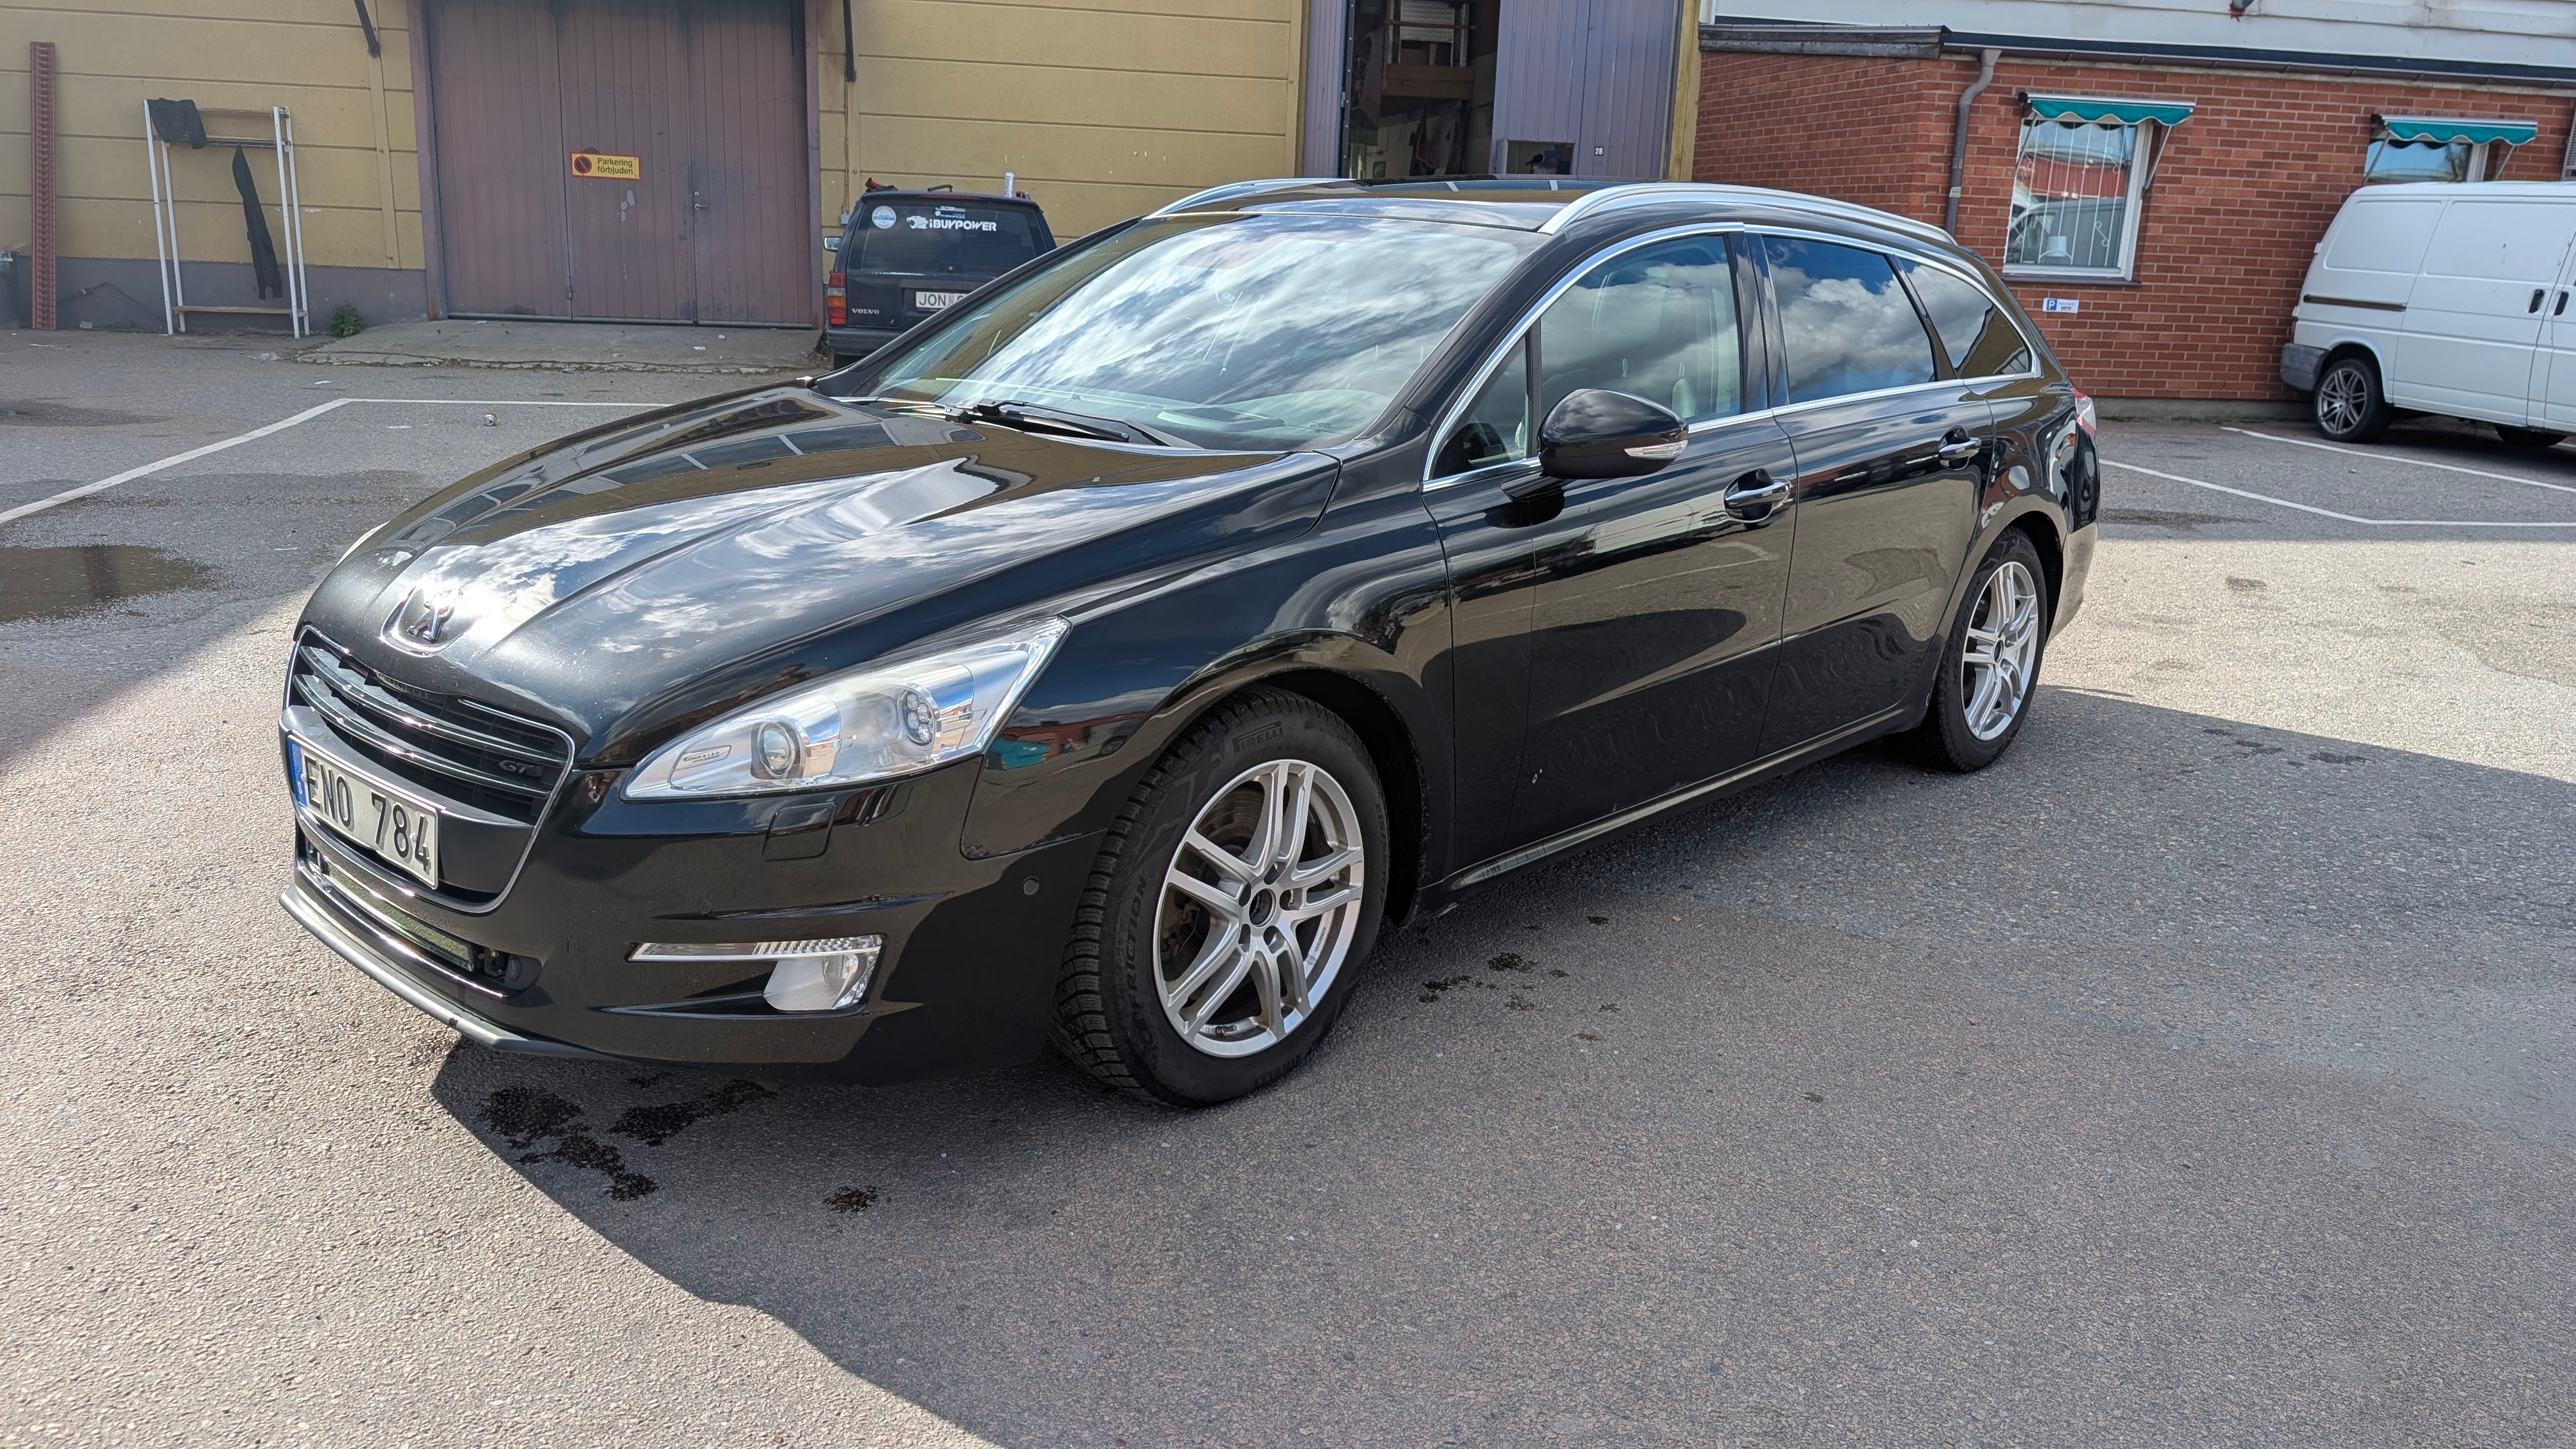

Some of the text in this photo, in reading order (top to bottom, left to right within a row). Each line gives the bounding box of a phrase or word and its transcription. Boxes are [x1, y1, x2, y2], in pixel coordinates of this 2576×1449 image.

[597, 157, 633, 167] Parkering
[597, 165, 633, 175] förbjuden
[929, 218, 997, 232] iBUYPOWER
[919, 294, 946, 306] JON
[1232, 721, 1284, 754] PIRELLI
[499, 760, 534, 774] GT
[303, 753, 431, 874] ENO 784
[1375, 804, 1387, 864] 215/55
